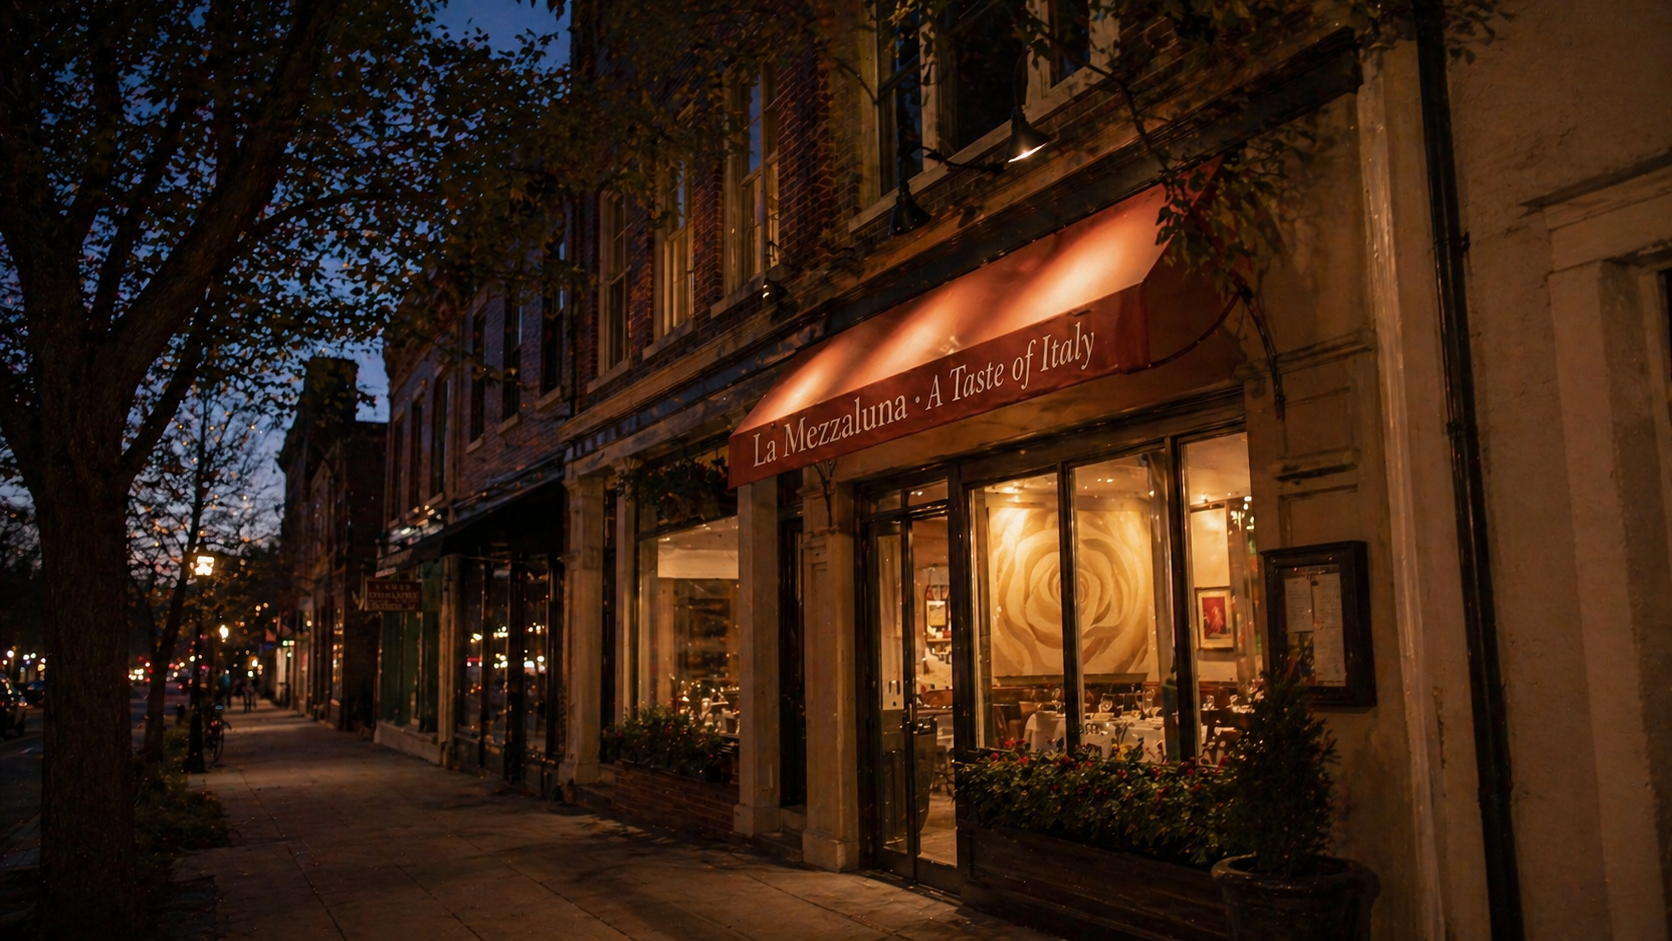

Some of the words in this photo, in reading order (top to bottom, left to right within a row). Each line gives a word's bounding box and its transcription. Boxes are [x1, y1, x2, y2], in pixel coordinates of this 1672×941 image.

[753, 433, 778, 467] La
[783, 395, 908, 458] Mezzaluna
[925, 374, 943, 411] A
[949, 363, 1004, 403] Taste
[1011, 339, 1037, 390] of
[1040, 321, 1095, 371] Italy
